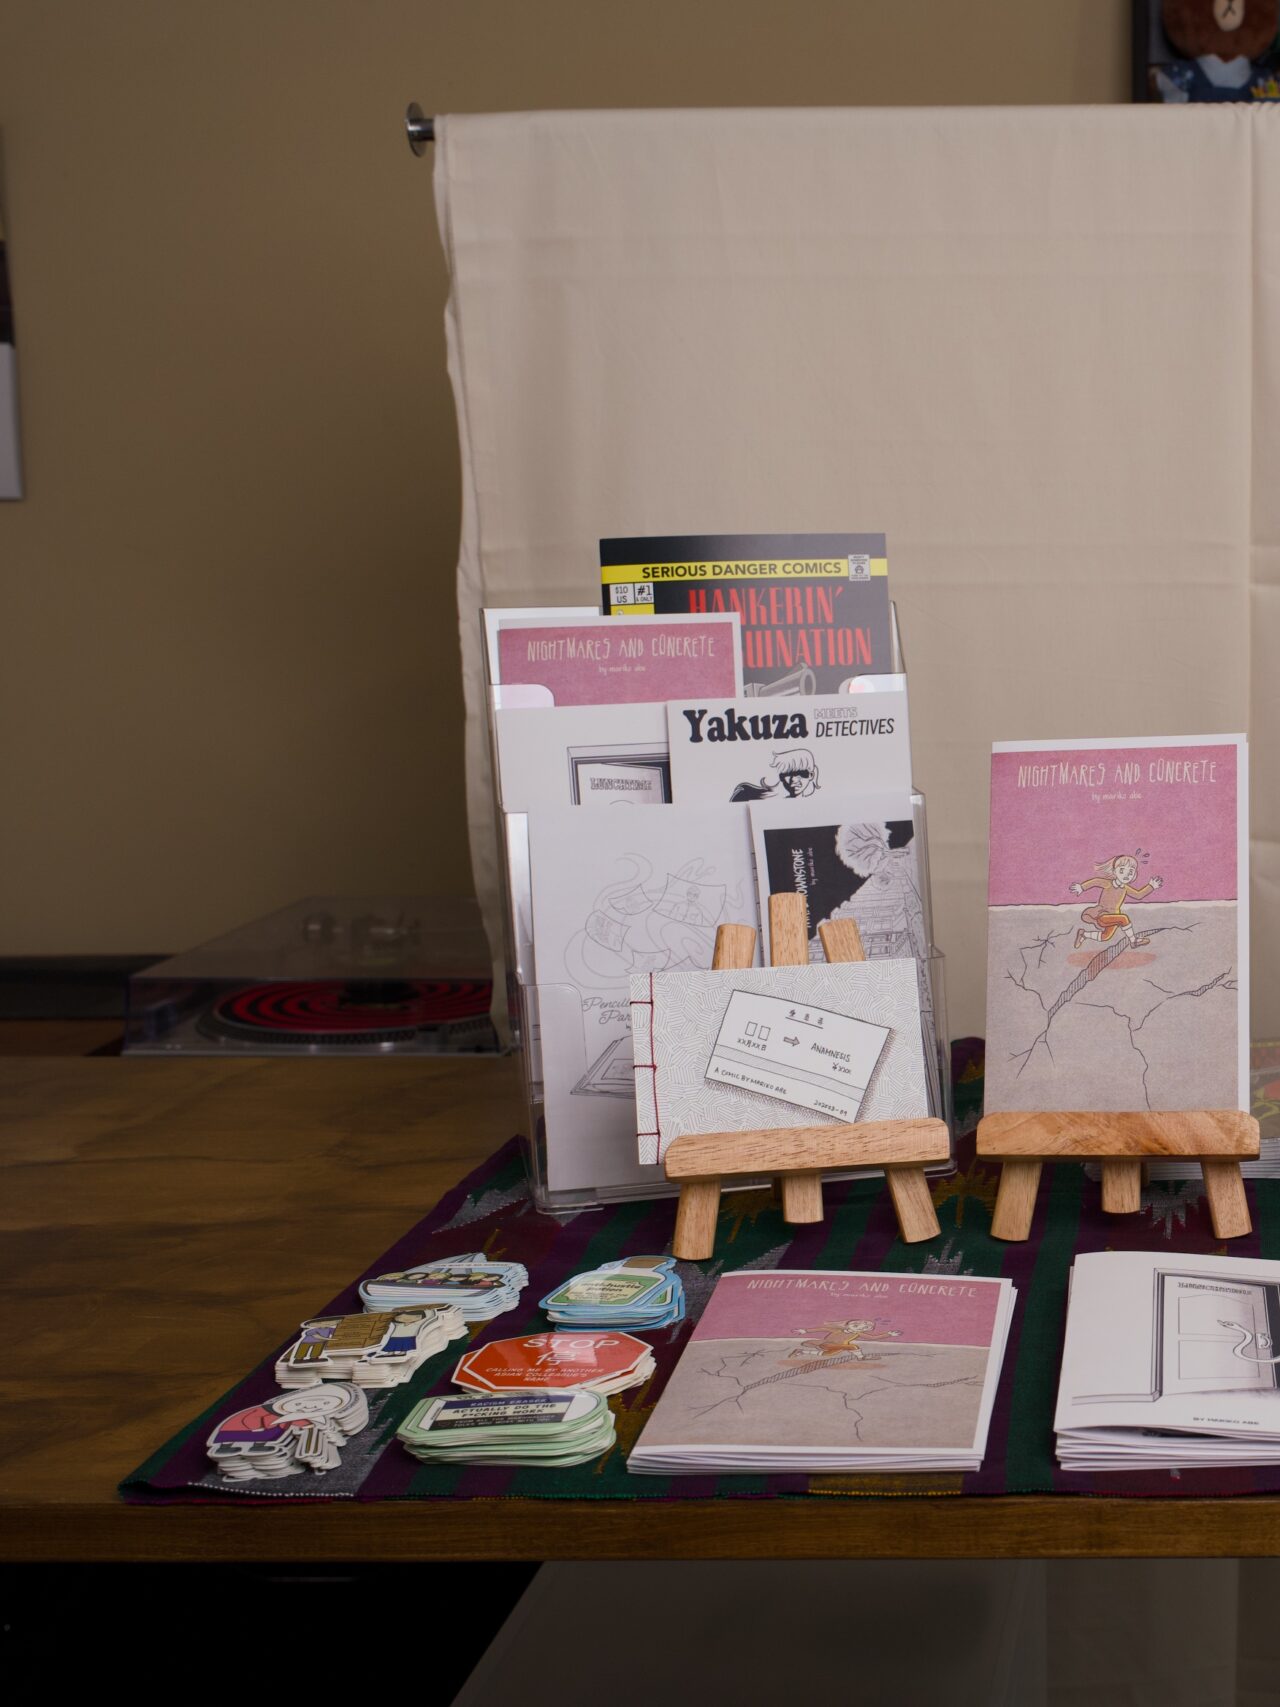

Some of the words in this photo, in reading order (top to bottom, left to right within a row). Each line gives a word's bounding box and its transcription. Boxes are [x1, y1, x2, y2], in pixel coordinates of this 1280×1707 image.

[642, 565, 707, 579] SERIOUS
[711, 563, 777, 577] DANGER
[781, 561, 842, 575] COMICS
[615, 585, 629, 594] $10
[616, 595, 628, 604] US
[637, 584, 653, 596] #1
[689, 586, 844, 625] HANKERIN'
[527, 636, 611, 662] NIGHTMARES
[619, 636, 644, 658] AND
[651, 633, 715, 659] CONCRETE
[745, 627, 873, 669] UINATION
[682, 708, 809, 743] Yakuza
[813, 707, 857, 720] MEETS
[815, 718, 895, 738] DETECTIVES
[1017, 761, 1106, 789] NIGHTMARES
[1114, 761, 1142, 785] AND
[1149, 758, 1218, 785] CONCRETE
[810, 1042, 851, 1062] ANAMNESIS
[746, 1278, 850, 1291] NIGHTMARES
[859, 1282, 890, 1293] AND
[898, 1282, 977, 1298] CONCRETE
[522, 1338, 621, 1349] STOP
[452, 1406, 510, 1414] ACTUALLY
